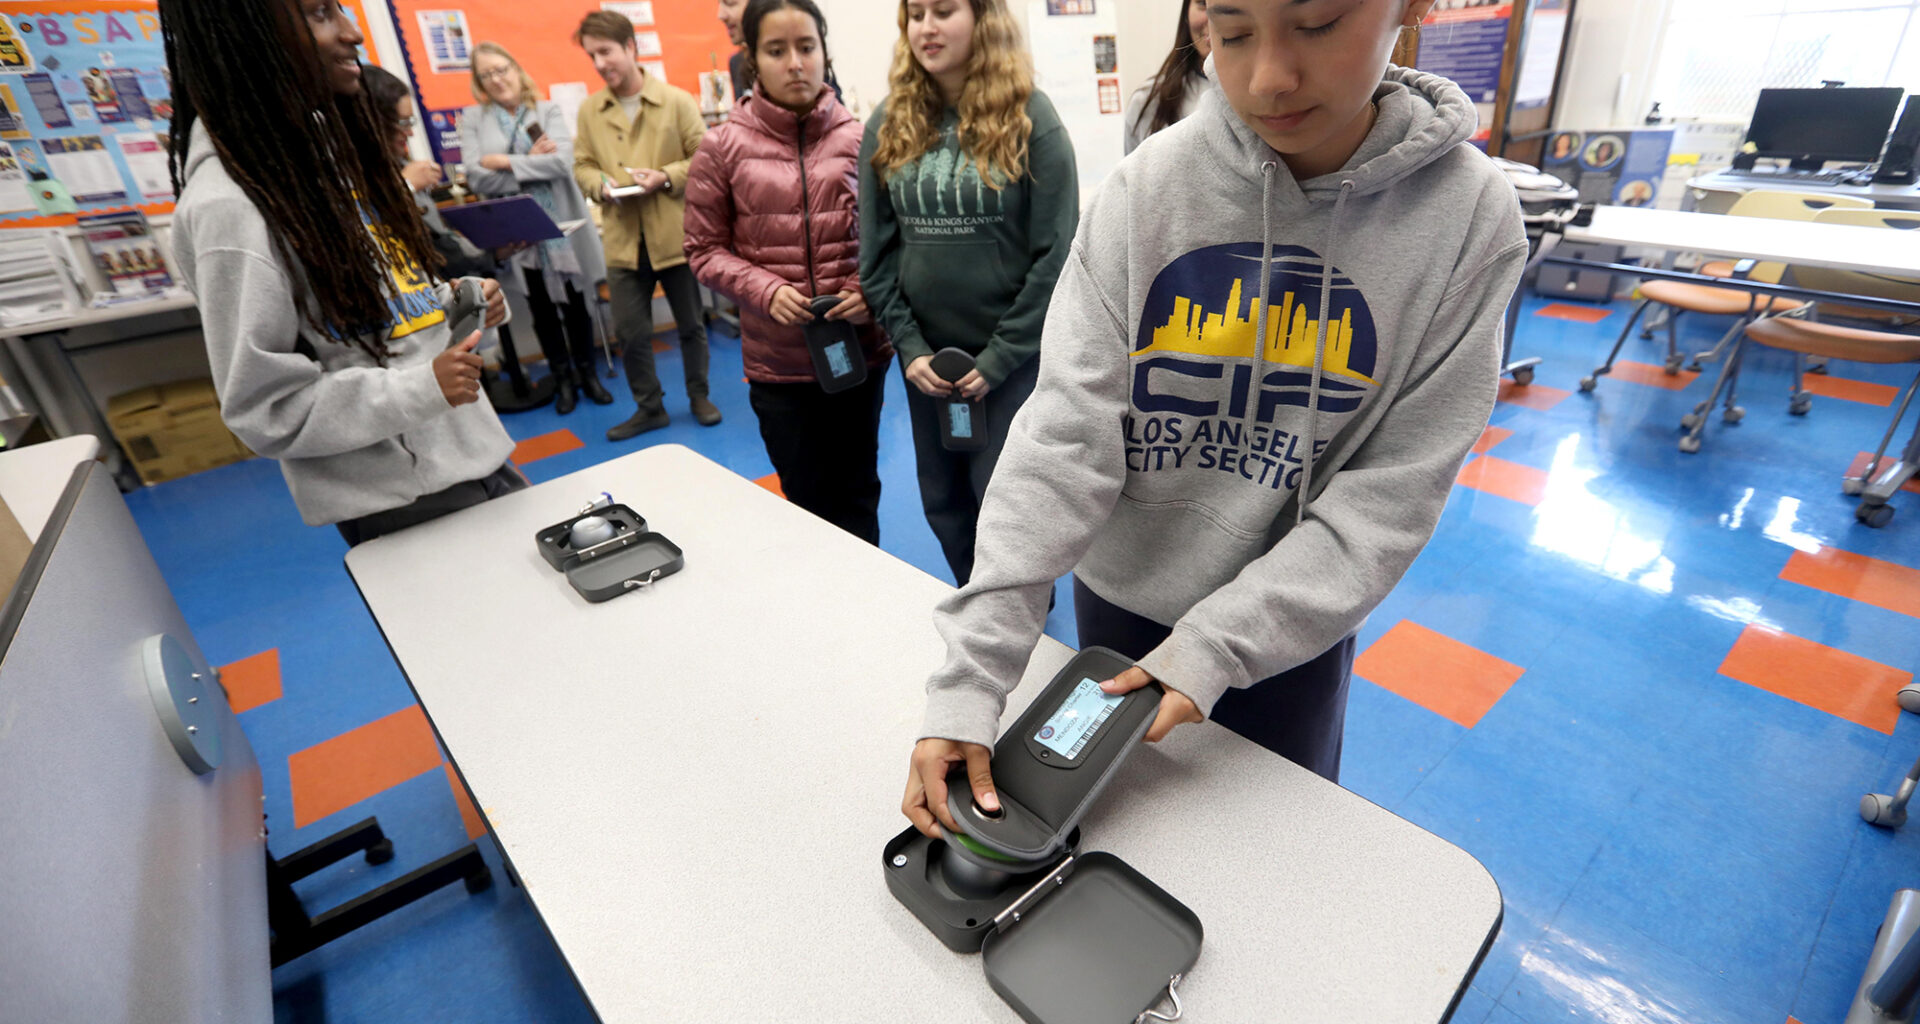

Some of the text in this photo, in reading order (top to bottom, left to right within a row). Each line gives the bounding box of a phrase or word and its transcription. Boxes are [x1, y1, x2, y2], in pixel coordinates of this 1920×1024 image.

[36, 14, 161, 46] BSAP
[914, 226, 976, 235] NATIONAL PARK
[934, 216, 962, 226] KINGS
[963, 215, 1004, 225] CANYON
[1132, 357, 1367, 423] CIF
[1126, 417, 1329, 464] LOS ANGELE
[1125, 445, 1304, 490] CITY SECTIO
[1080, 682, 1089, 691] 12
